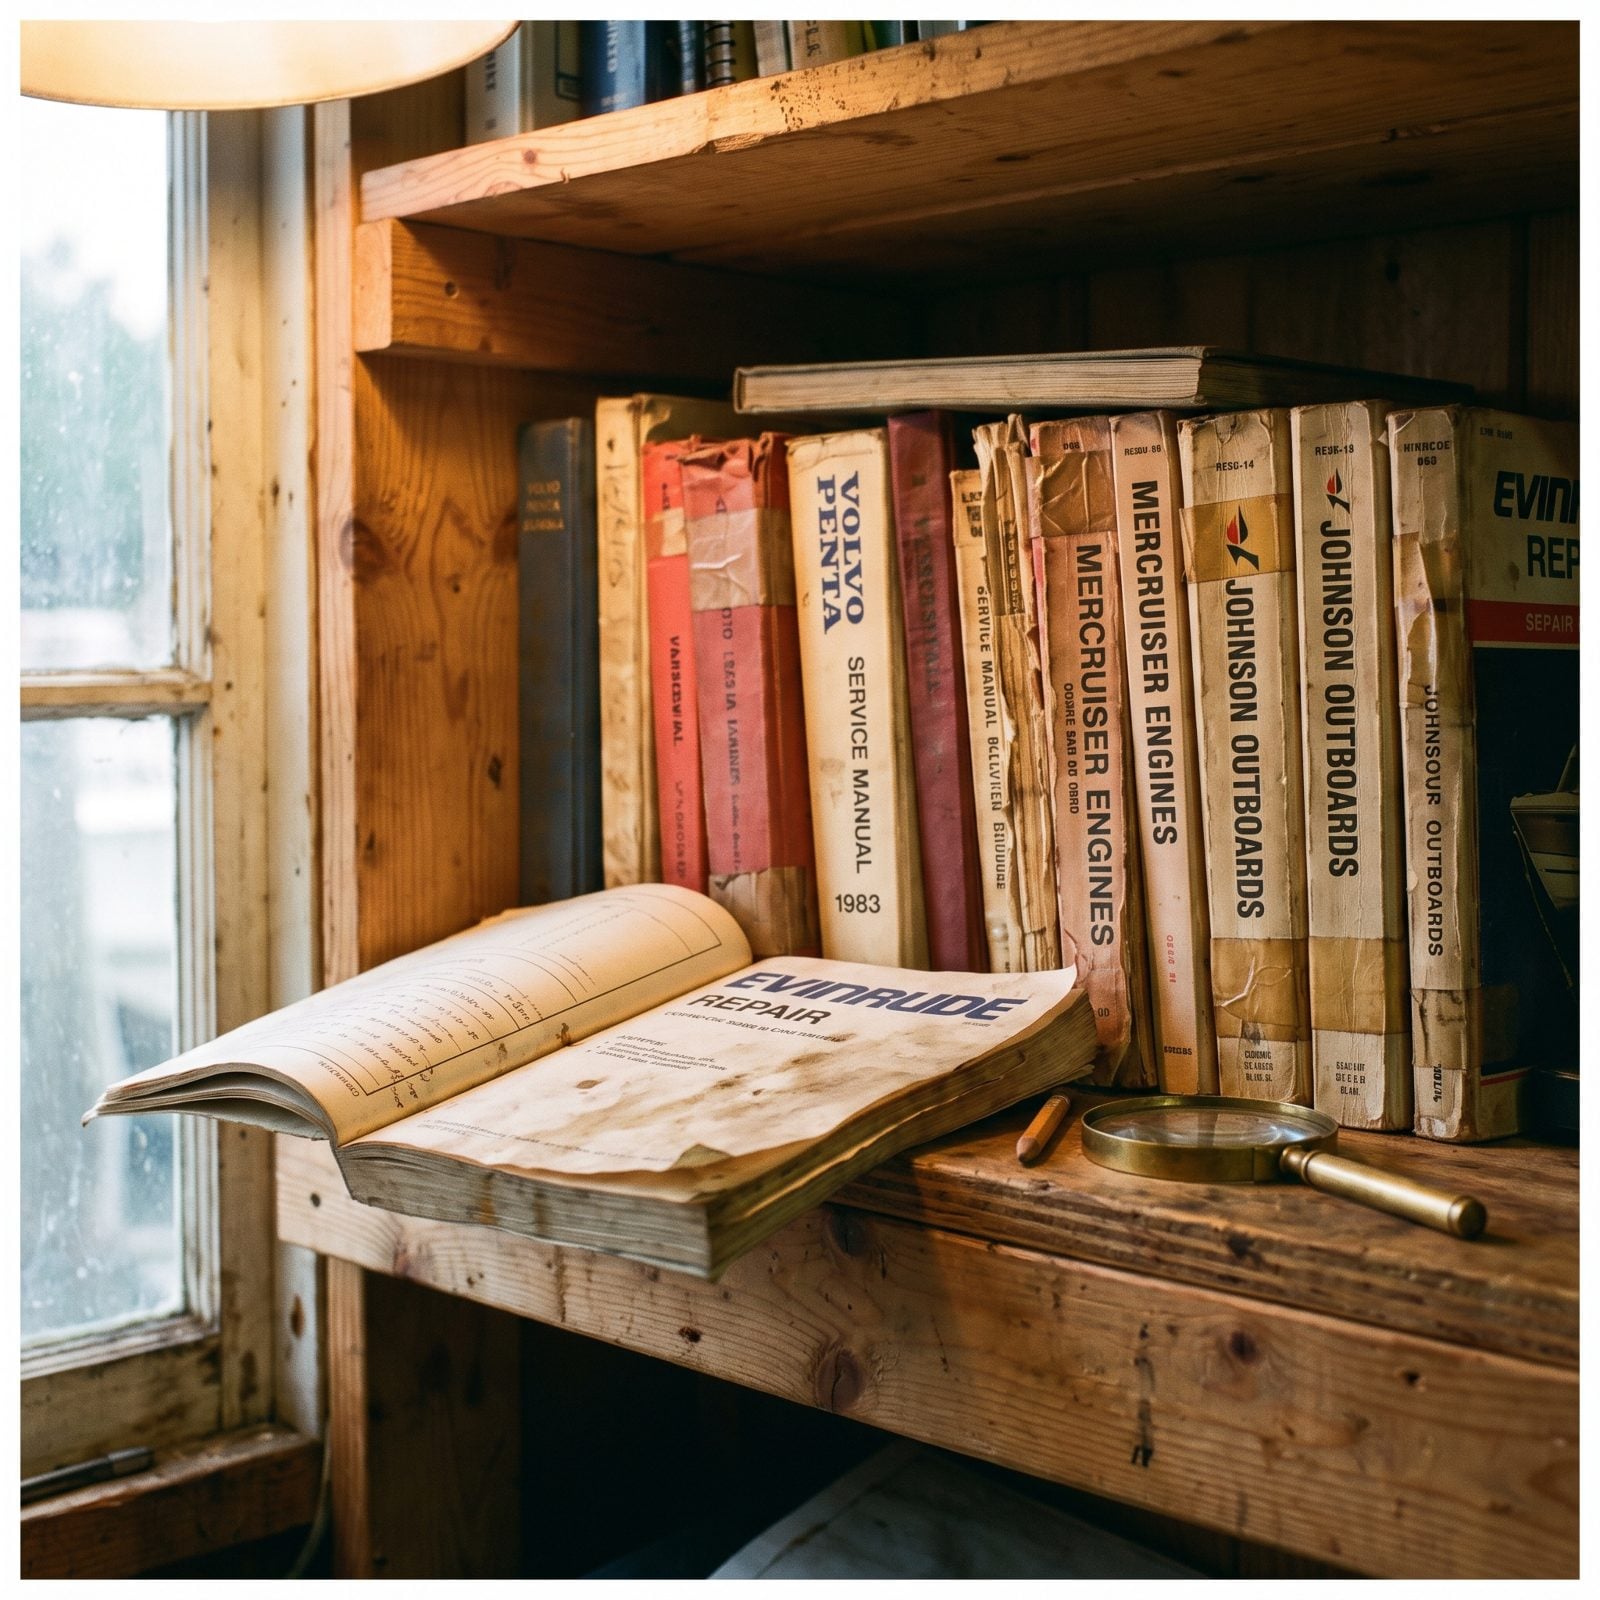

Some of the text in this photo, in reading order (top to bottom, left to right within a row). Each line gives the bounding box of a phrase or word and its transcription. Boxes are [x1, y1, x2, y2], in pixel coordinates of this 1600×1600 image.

[816, 474, 843, 634] PENTA
[839, 470, 865, 625] VOLVO
[977, 585, 992, 653] SERVICE
[981, 660, 998, 728] MANUAL
[1131, 480, 1178, 845] MERCRUISER ENGINES
[1320, 520, 1359, 878] JOHNSON OUTBOARDS
[847, 655, 873, 874] SERVICE MANUAL
[1076, 544, 1114, 946] MERCRUISER ENGINES
[1225, 579, 1265, 919] JOHNSON OUTBOARDS
[834, 893, 881, 914] 1983
[1426, 819, 1444, 957] OUTBOARDS
[688, 994, 831, 1026] REPAIR
[725, 971, 1030, 1023] EVINRUDE
